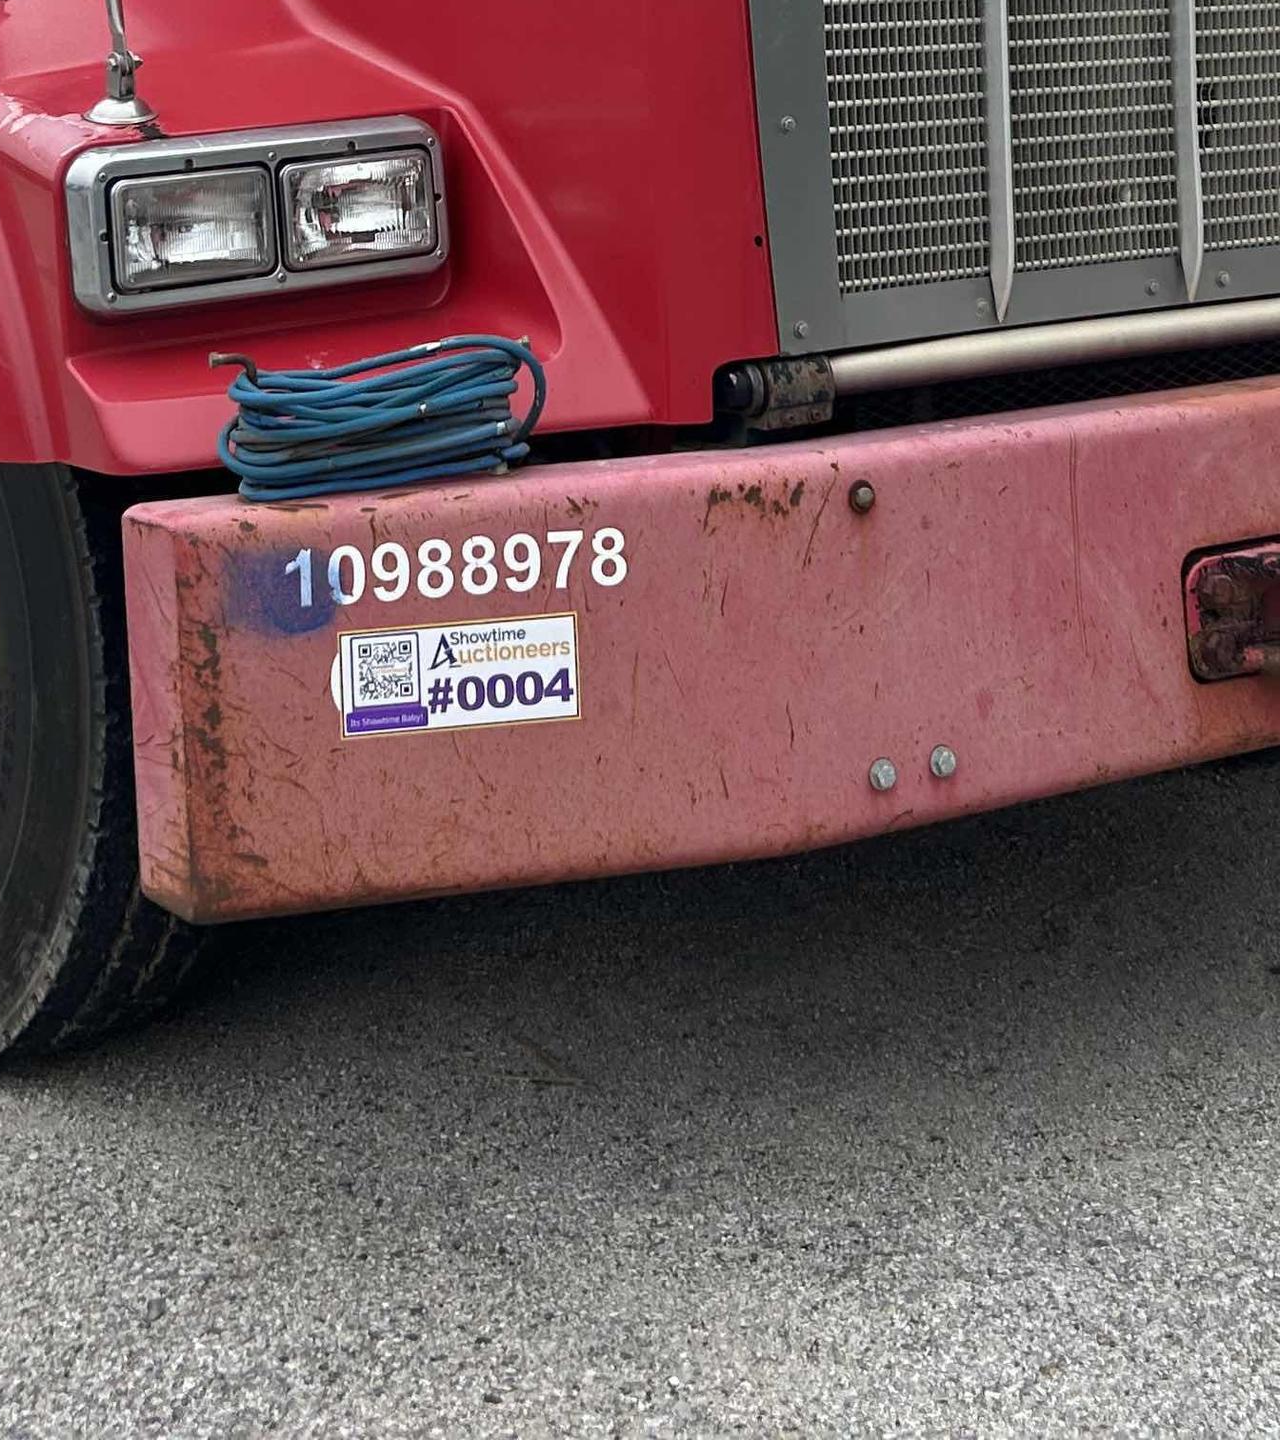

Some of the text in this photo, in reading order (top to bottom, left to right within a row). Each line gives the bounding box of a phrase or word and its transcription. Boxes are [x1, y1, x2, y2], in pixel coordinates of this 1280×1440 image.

[285, 526, 628, 607] 10988978
[449, 626, 526, 646] Showtime
[427, 668, 575, 714] #0004
